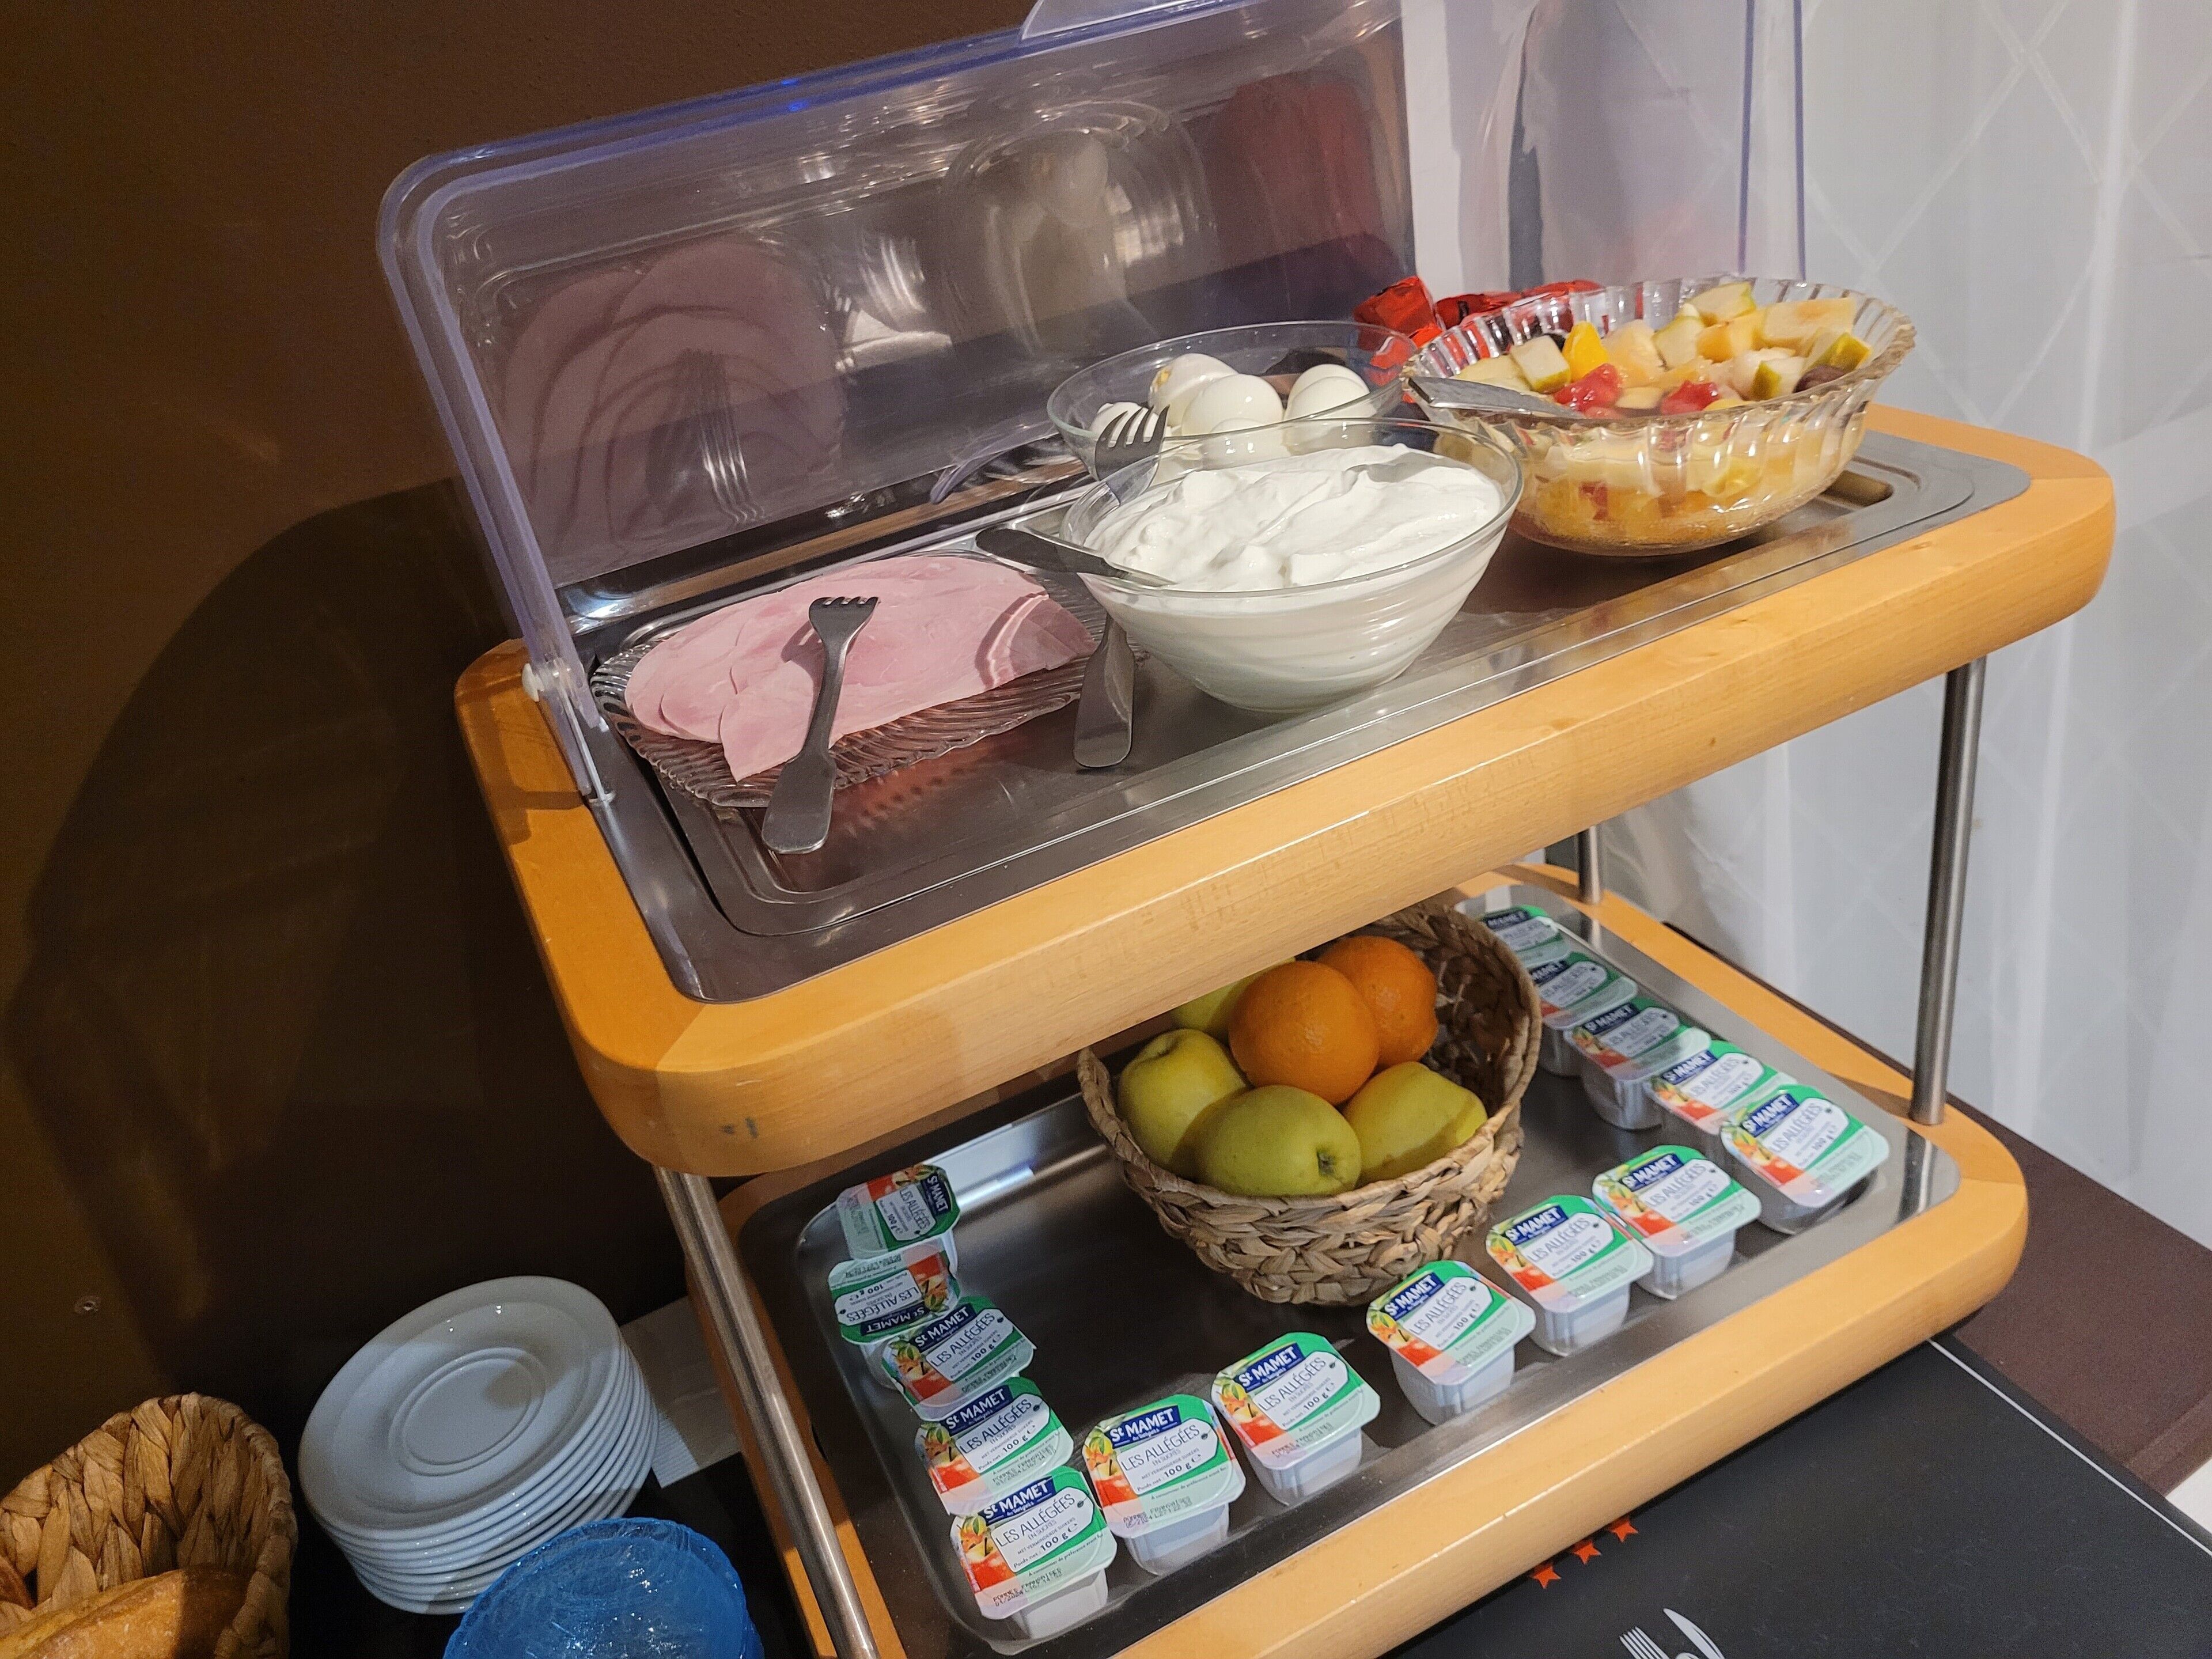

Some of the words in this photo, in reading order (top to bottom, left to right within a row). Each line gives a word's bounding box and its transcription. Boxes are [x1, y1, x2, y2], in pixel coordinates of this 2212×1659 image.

[1517, 1207, 1562, 1238] MAMET
[867, 1284, 883, 1294] 100
[899, 1286, 919, 1301] LES
[1395, 1274, 1438, 1309] MAMET
[846, 1298, 898, 1321] ALLÉGÉES
[866, 1312, 911, 1333] MAMET
[914, 1306, 925, 1317] St
[1409, 1319, 1431, 1335] LES
[1426, 1282, 1467, 1323] ALLÉGÉES
[1454, 1317, 1468, 1330] 100
[915, 1334, 929, 1347] St
[929, 1306, 969, 1340] MAMET
[930, 1350, 952, 1367] LES
[950, 1313, 995, 1354] ALLÉGÉES
[971, 1348, 987, 1361] 100
[1238, 1372, 1253, 1387] St
[1251, 1346, 1298, 1380] MAMET
[1258, 1393, 1281, 1411] LES
[1279, 1357, 1326, 1399] ALLÉGÉES
[946, 1415, 960, 1429] St
[960, 1388, 1006, 1424] MAMET
[1304, 1396, 1320, 1410] 100
[960, 1437, 983, 1454] LES
[982, 1398, 1032, 1442] ALLÉGÉES
[1109, 1427, 1124, 1442] St
[1124, 1408, 1174, 1437] MAMET
[1002, 1439, 1019, 1453] 100
[1121, 1452, 1145, 1471] LES
[1145, 1424, 1200, 1462] ALLÉGÉES
[1164, 1465, 1182, 1478] 100
[983, 1503, 998, 1518] St
[999, 1479, 1048, 1513] MAMET
[995, 1528, 1020, 1547] LES
[1020, 1493, 1075, 1537] ALLÉGÉES
[1040, 1536, 1059, 1551] 100
[1062, 1532, 1069, 1540] g
